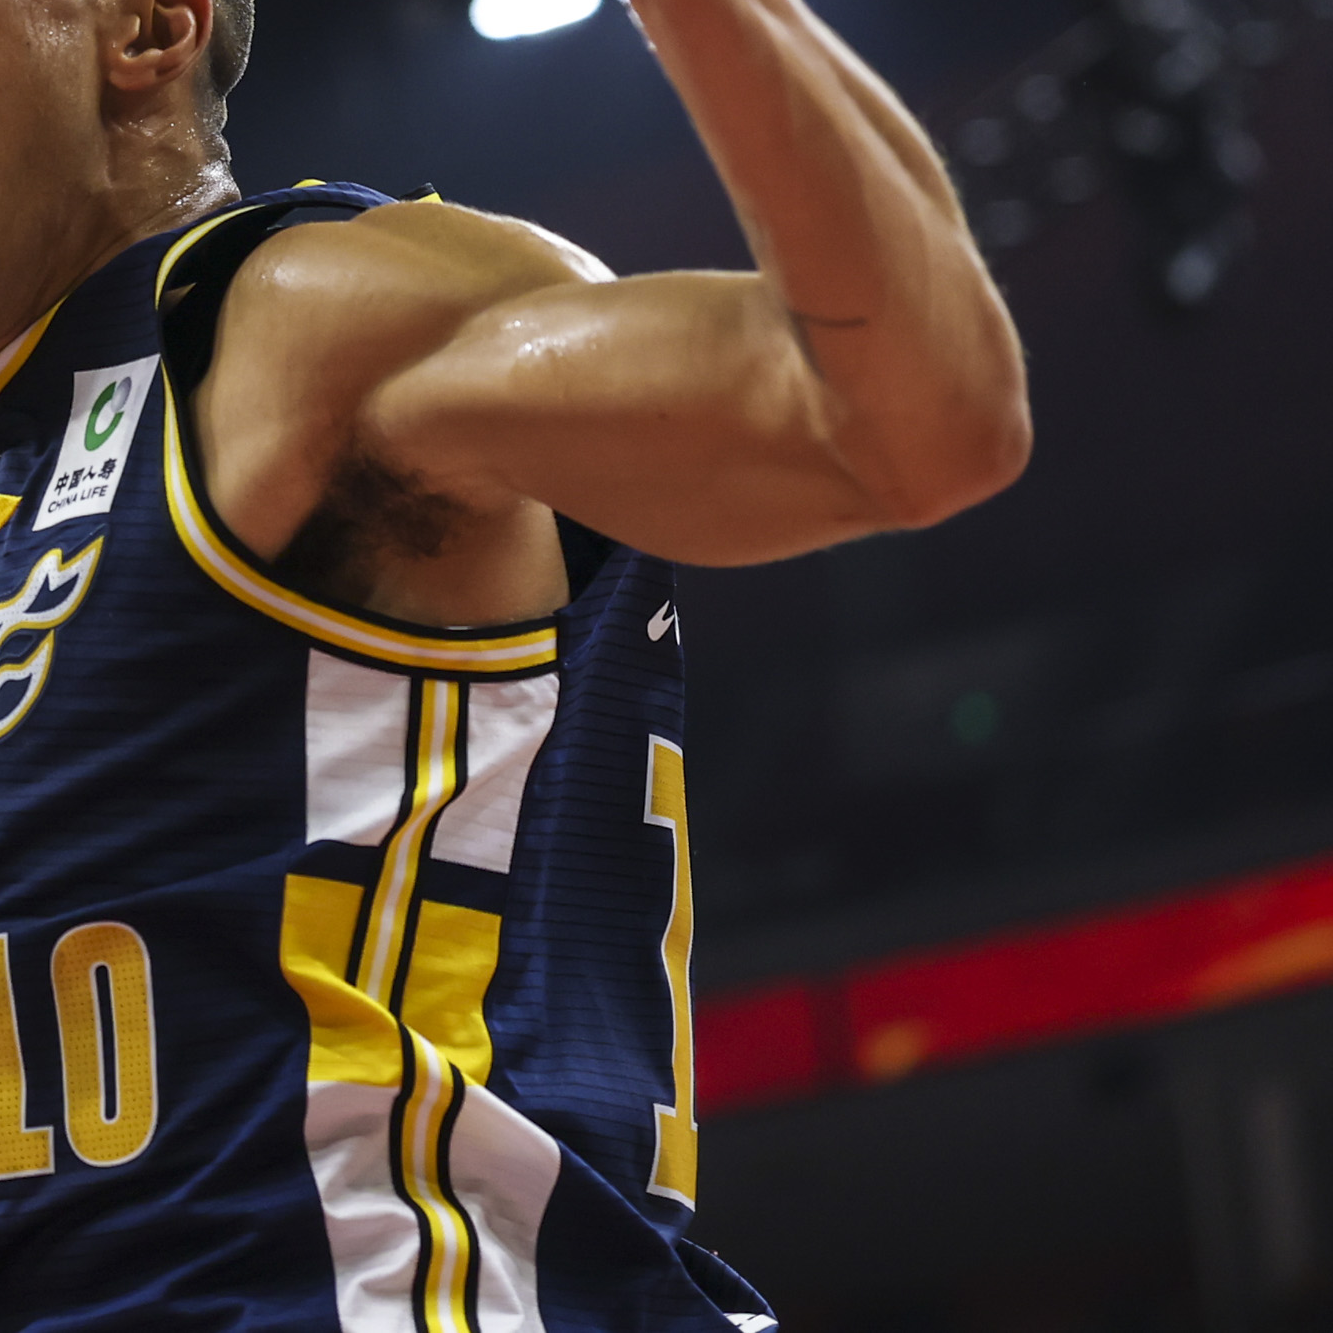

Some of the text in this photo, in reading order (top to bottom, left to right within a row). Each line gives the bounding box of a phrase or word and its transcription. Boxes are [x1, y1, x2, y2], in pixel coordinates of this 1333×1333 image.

[54, 458, 117, 496] 中国人寿
[47, 484, 109, 513] CHINA LIFE
